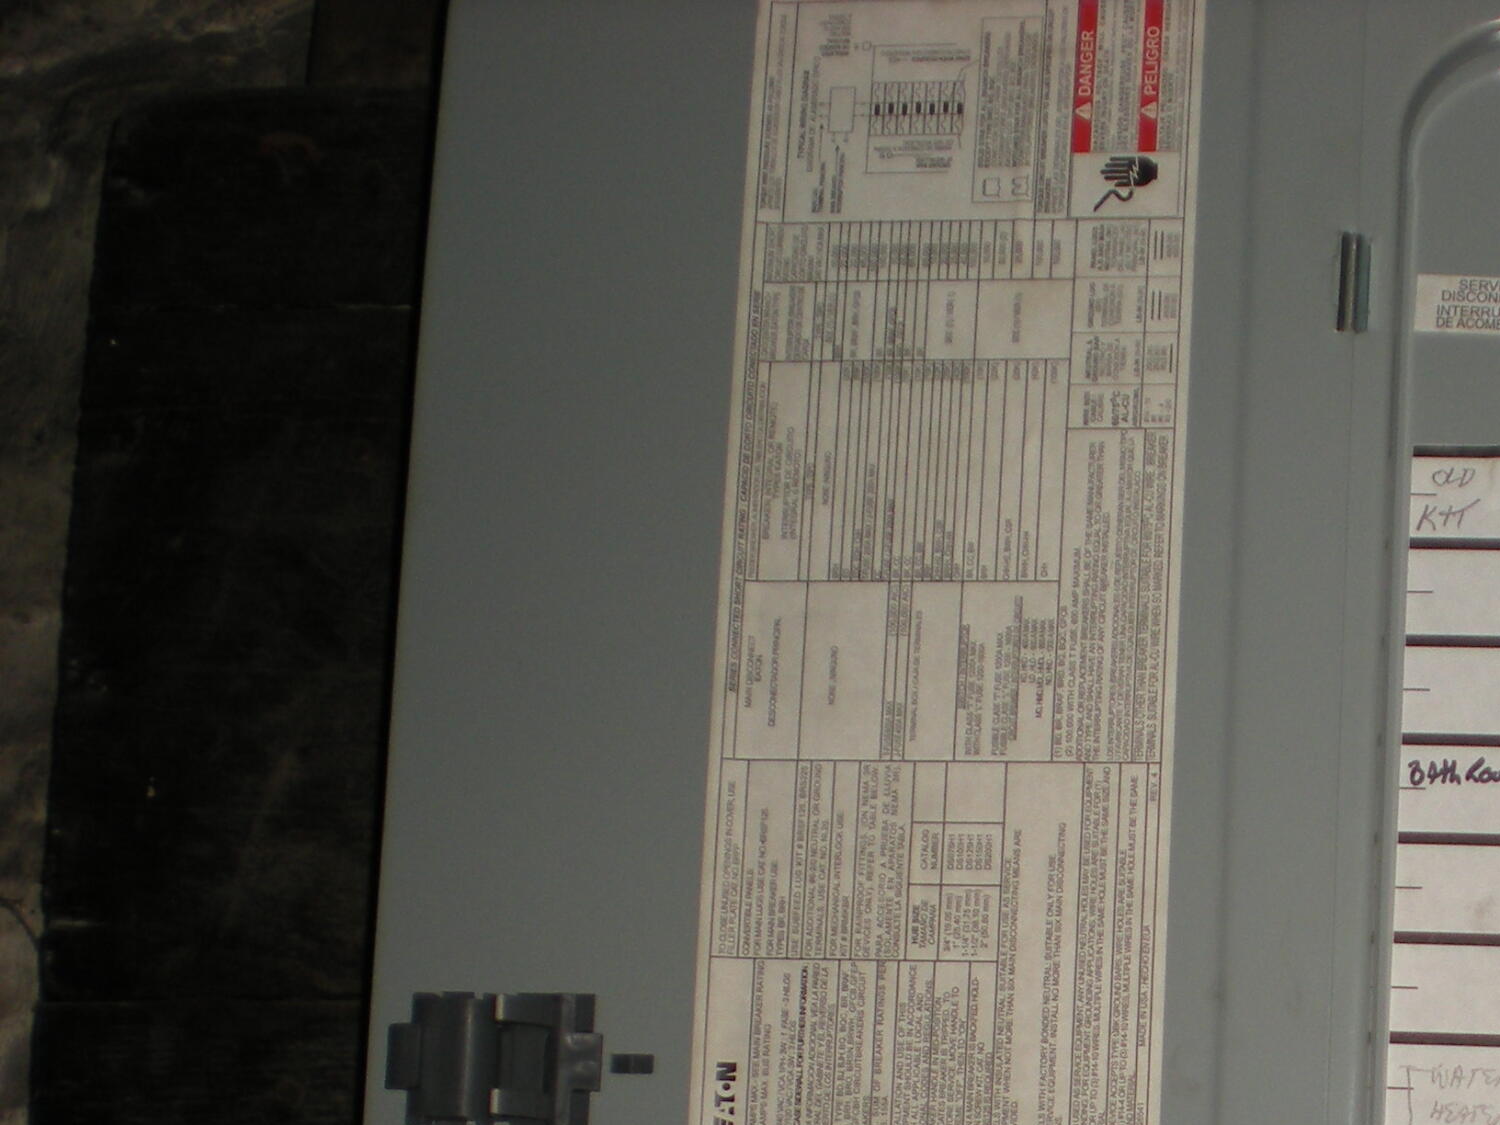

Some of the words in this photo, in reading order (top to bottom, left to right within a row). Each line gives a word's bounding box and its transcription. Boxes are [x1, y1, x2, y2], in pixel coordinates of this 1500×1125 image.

[1078, 30, 1095, 96] DANGER
[1143, 26, 1161, 96] PELIGRO
[1435, 317, 1454, 328] DE
